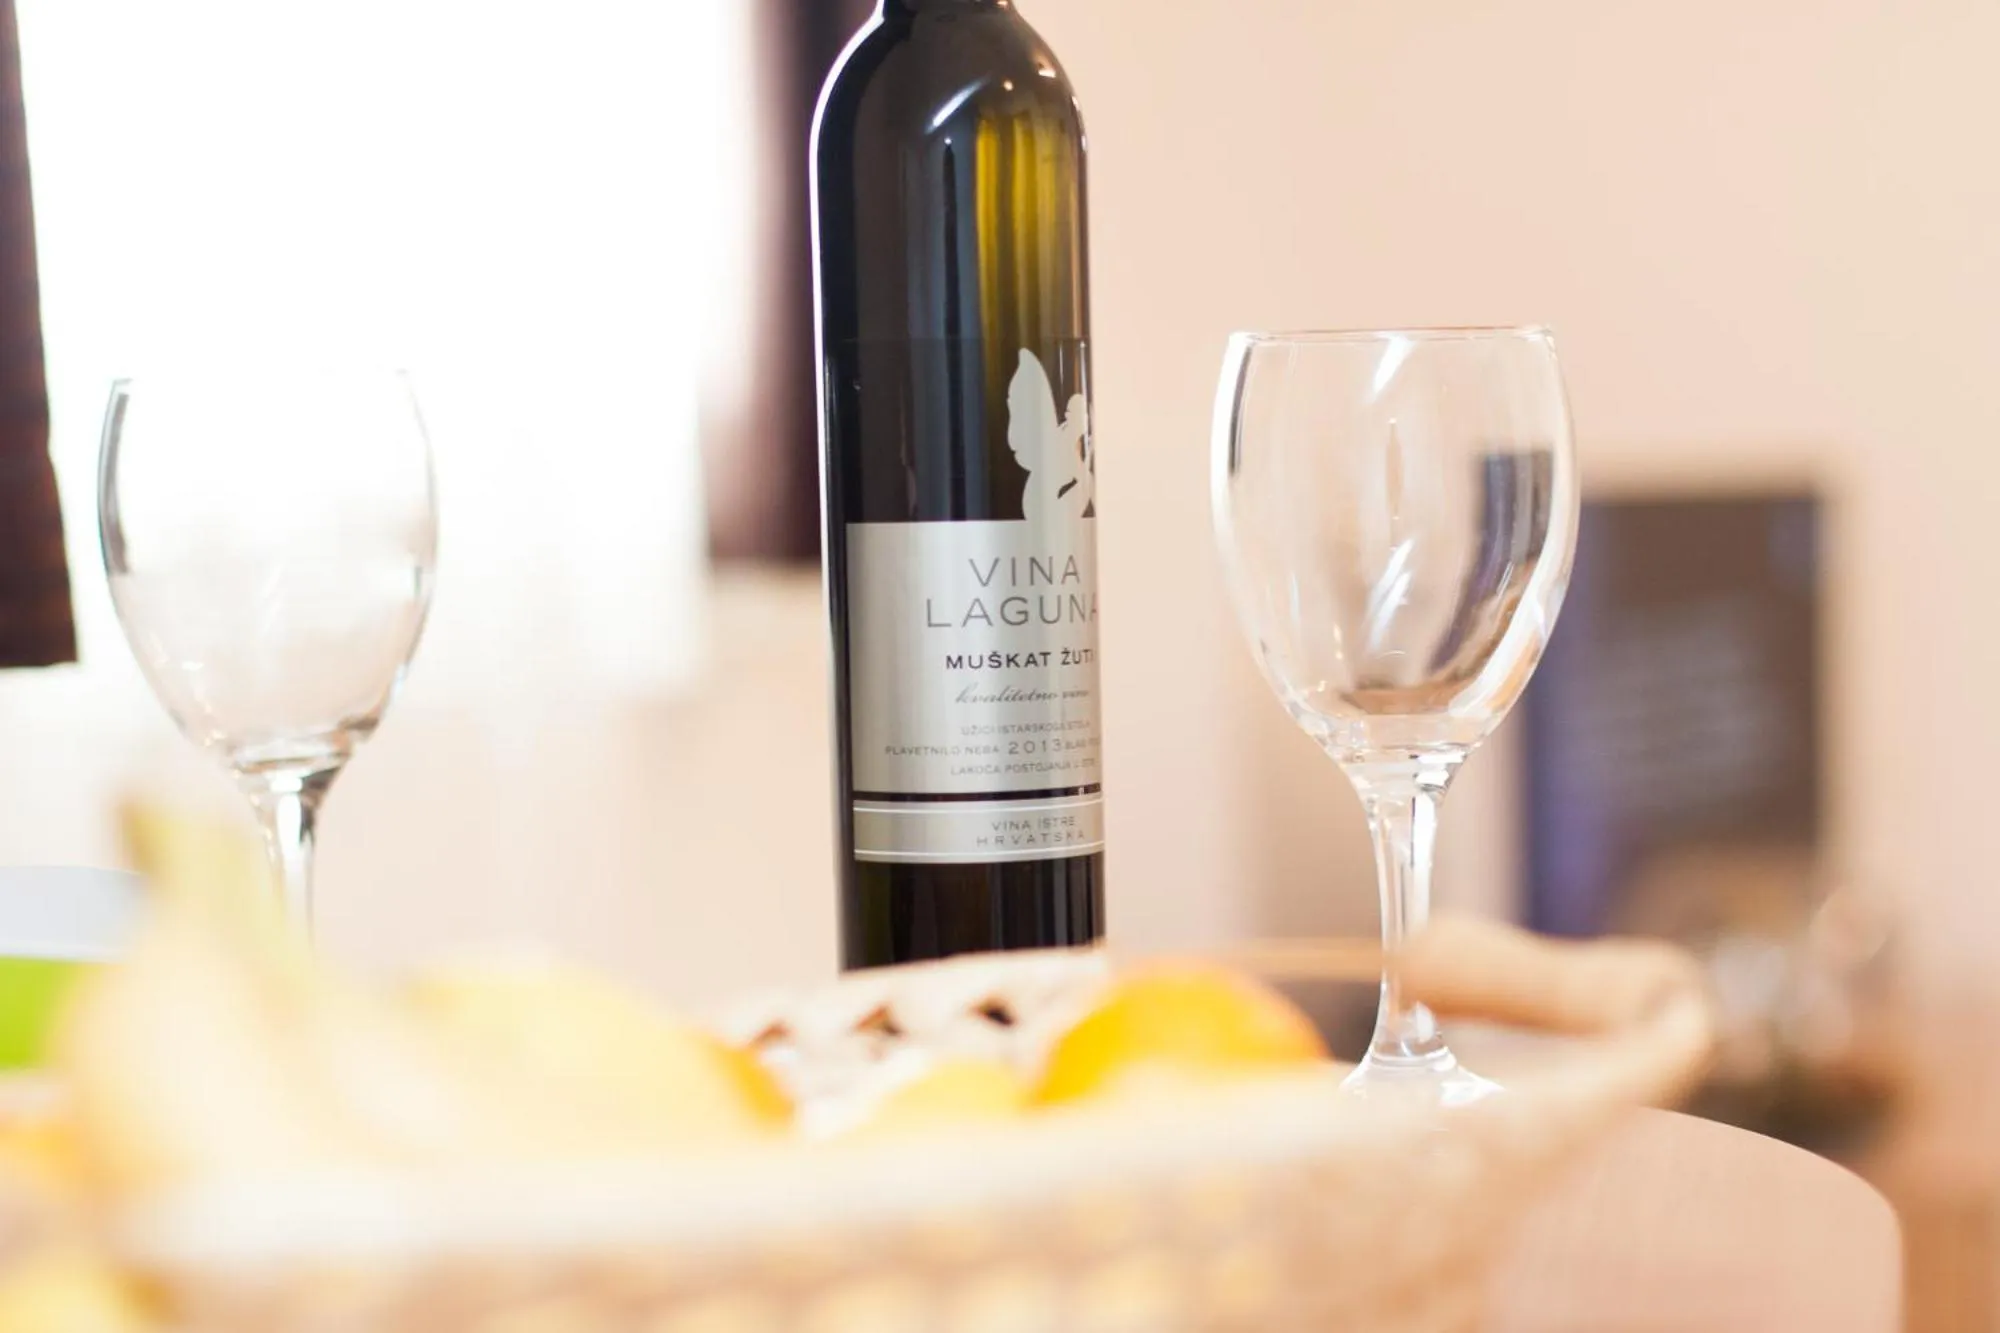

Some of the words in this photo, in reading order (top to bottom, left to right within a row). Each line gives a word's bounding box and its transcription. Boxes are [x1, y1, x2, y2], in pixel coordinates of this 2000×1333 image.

[969, 555, 1080, 587] VINA
[946, 651, 1051, 670] MUŠKAT
[1008, 738, 1062, 755] 2013
[991, 819, 1032, 831] VINA
[1037, 815, 1076, 829] ISTRE
[976, 830, 1085, 846] HRVATSKA
